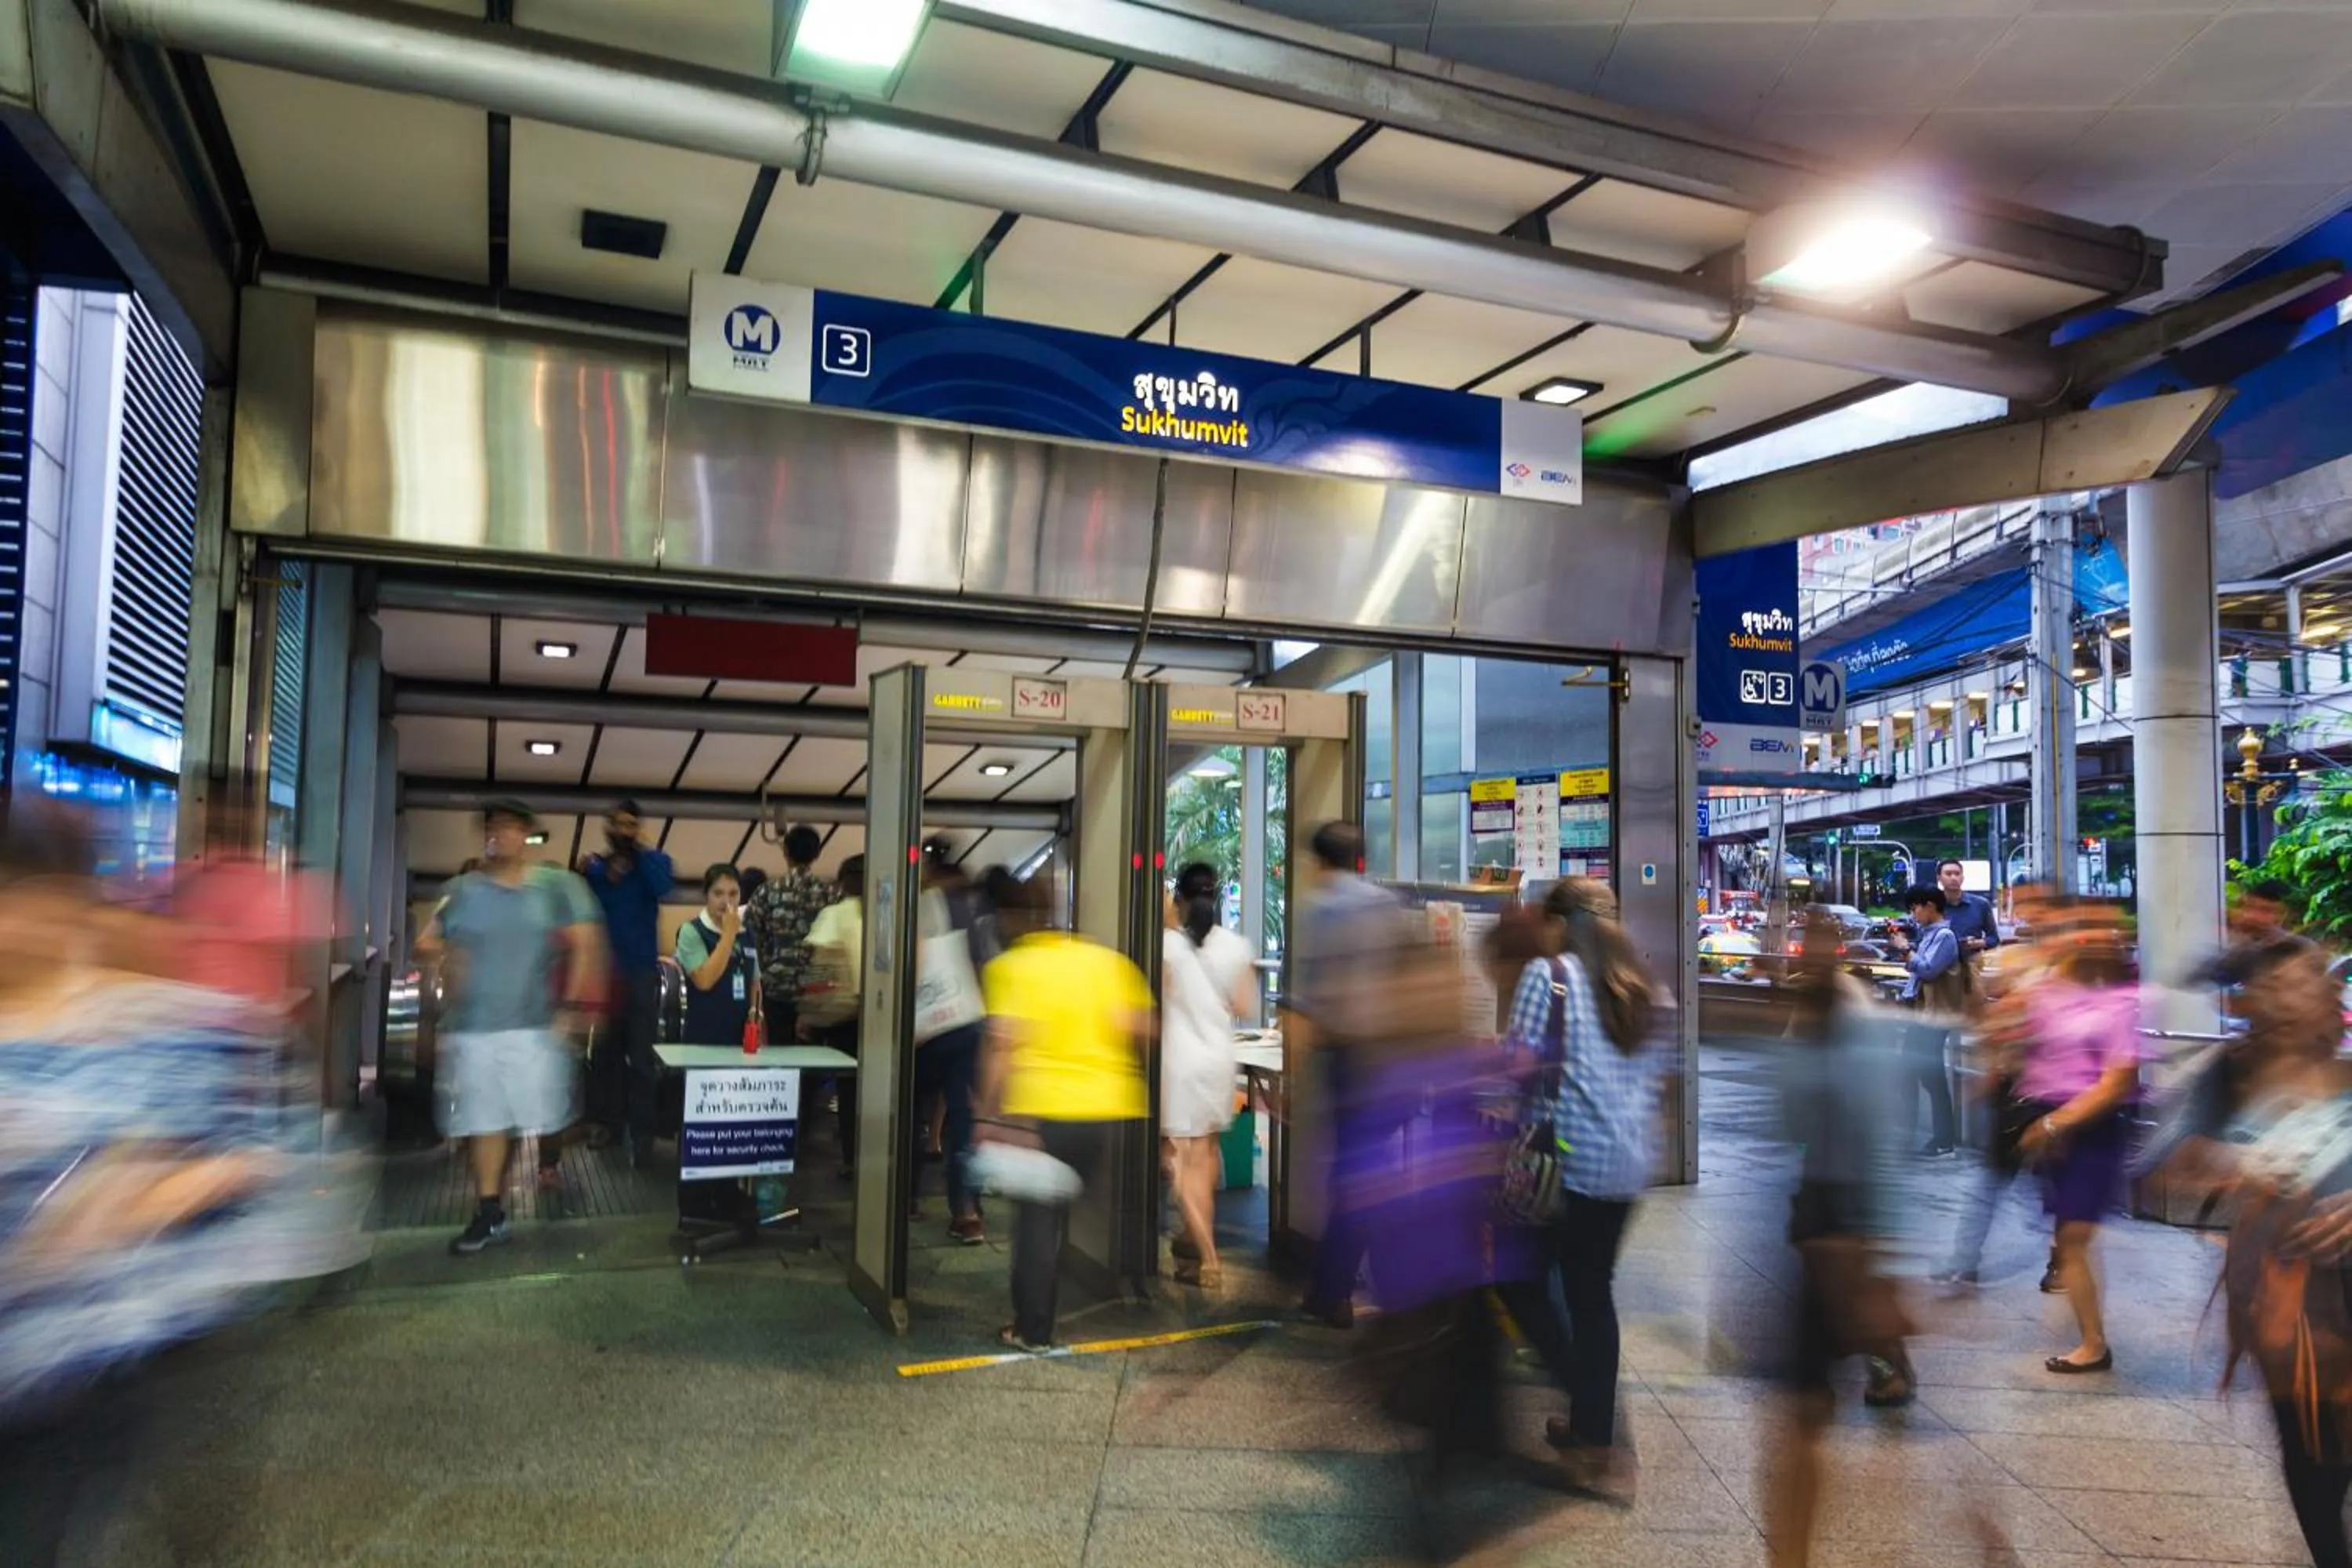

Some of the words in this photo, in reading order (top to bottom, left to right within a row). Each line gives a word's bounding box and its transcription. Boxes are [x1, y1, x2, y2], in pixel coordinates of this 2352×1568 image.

[837, 332, 858, 366] 3
[1134, 371, 1239, 415] สุขุมวิท
[1121, 405, 1248, 448] Sukhumvit
[1741, 608, 1793, 635] สุขุมวิท
[1730, 633, 1792, 652] Sukhumvit
[1018, 689, 1062, 708] S-20
[1774, 678, 1786, 699] 3
[1242, 702, 1279, 721] S-21
